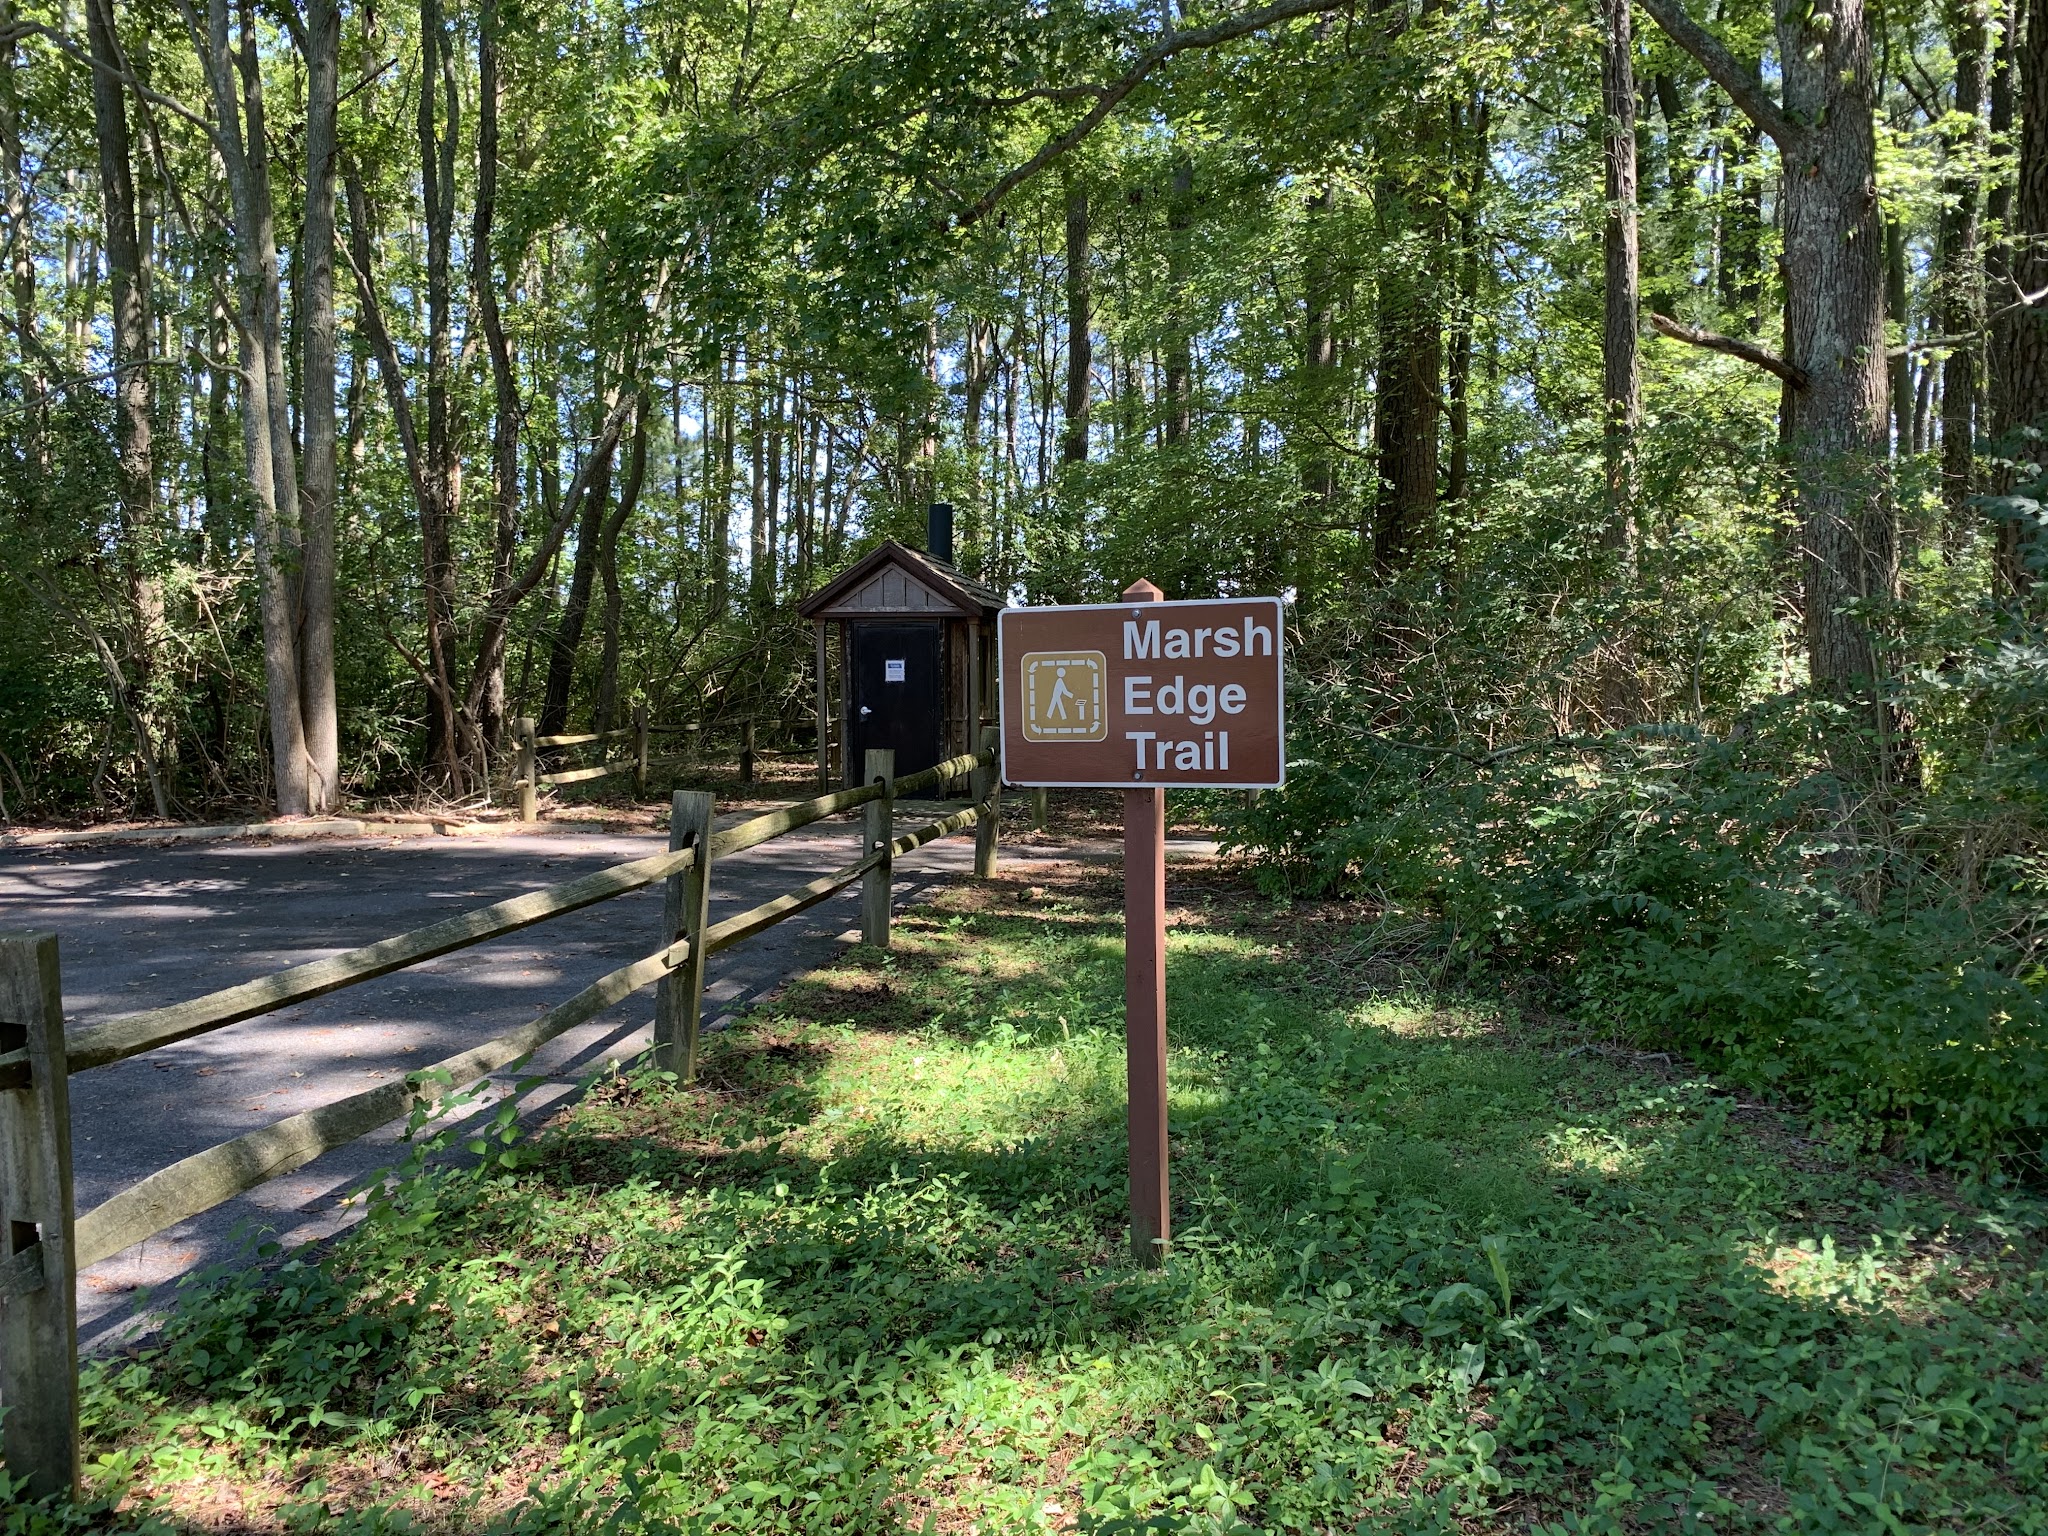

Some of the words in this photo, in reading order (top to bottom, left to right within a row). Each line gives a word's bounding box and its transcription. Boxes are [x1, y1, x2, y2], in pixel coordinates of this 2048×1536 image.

[1123, 616, 1272, 660] Marsh
[1124, 675, 1247, 725] Edge
[1125, 731, 1229, 770] Trail
